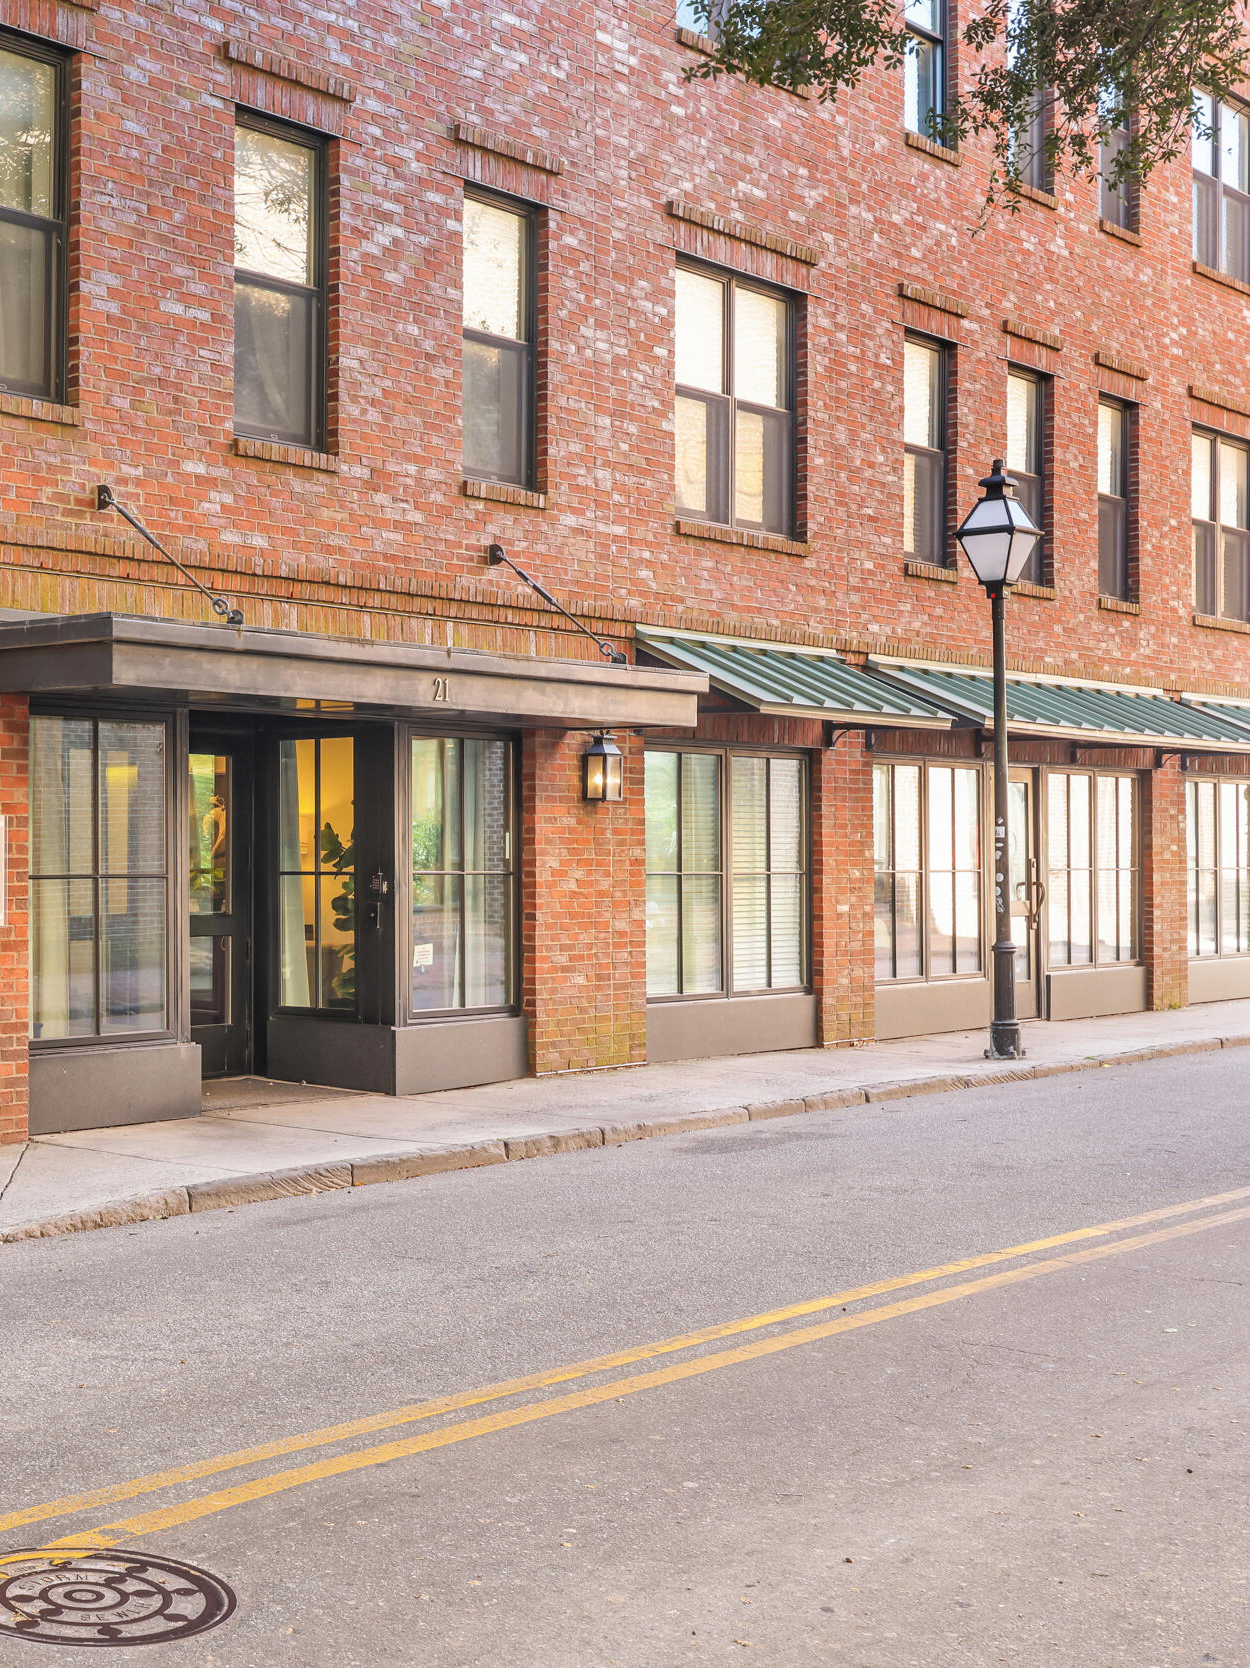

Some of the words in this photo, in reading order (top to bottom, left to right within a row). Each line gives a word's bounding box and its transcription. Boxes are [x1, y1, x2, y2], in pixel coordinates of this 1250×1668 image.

[433, 677, 449, 702] 21
[19, 1573, 89, 1592] STORM
[79, 1602, 152, 1622] SEWER
